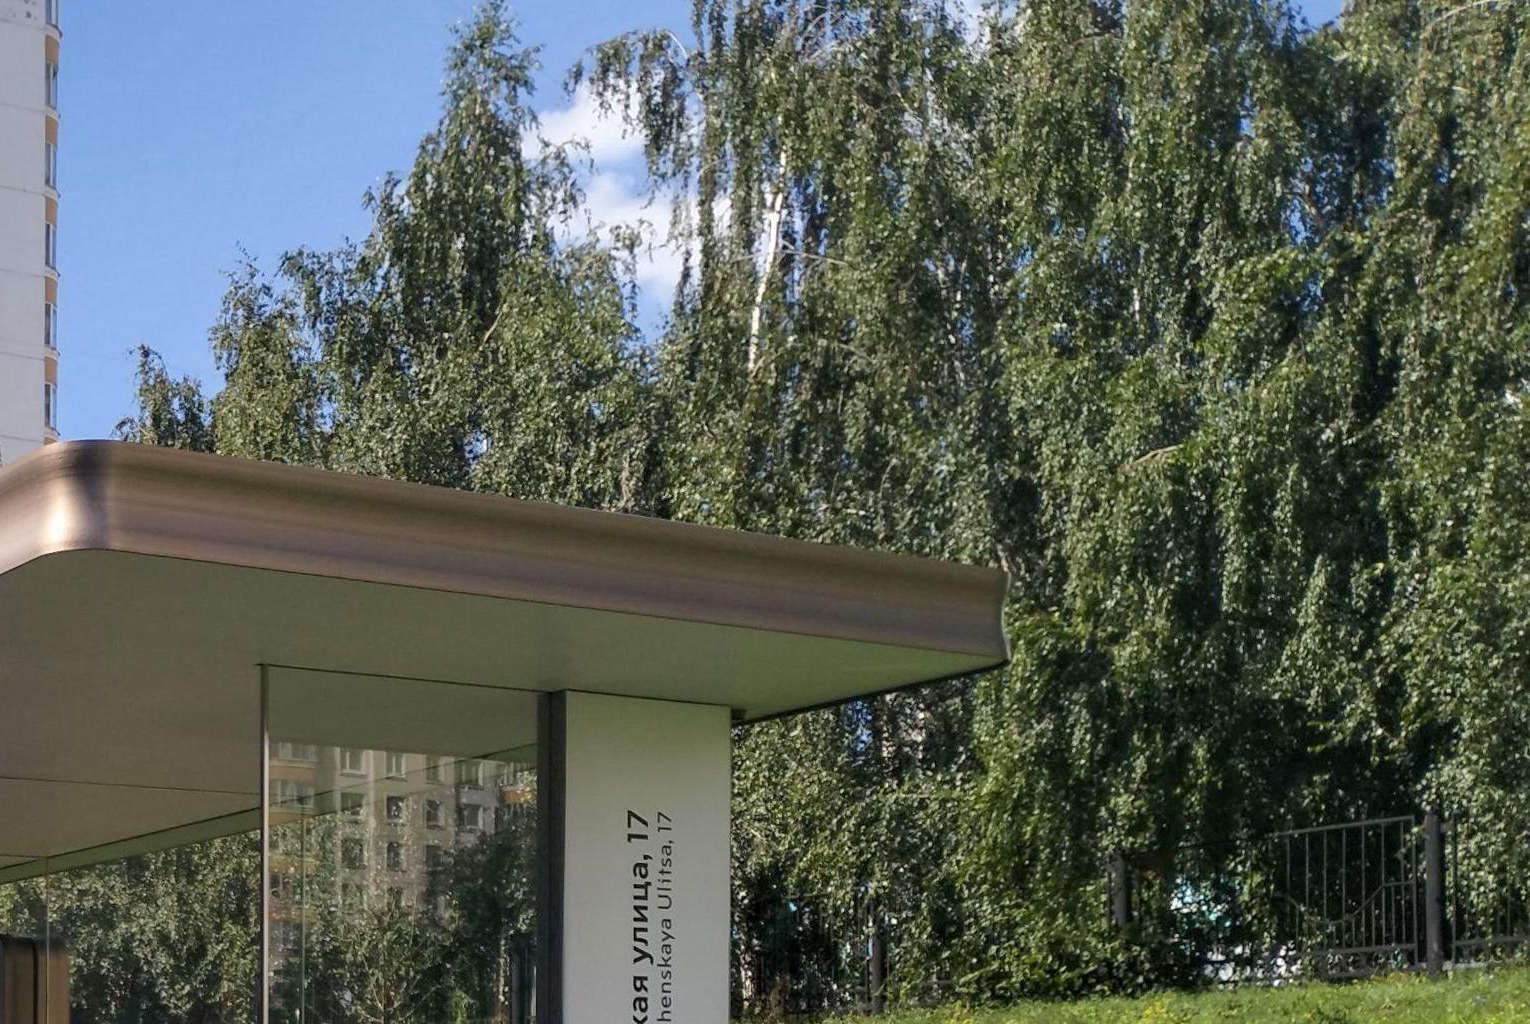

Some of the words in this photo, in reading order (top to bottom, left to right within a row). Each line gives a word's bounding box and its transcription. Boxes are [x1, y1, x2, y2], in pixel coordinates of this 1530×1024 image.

[626, 809, 649, 844] 17
[656, 811, 673, 833] 17
[656, 839, 675, 910] Ulitsa,
[632, 854, 655, 966] улица,
